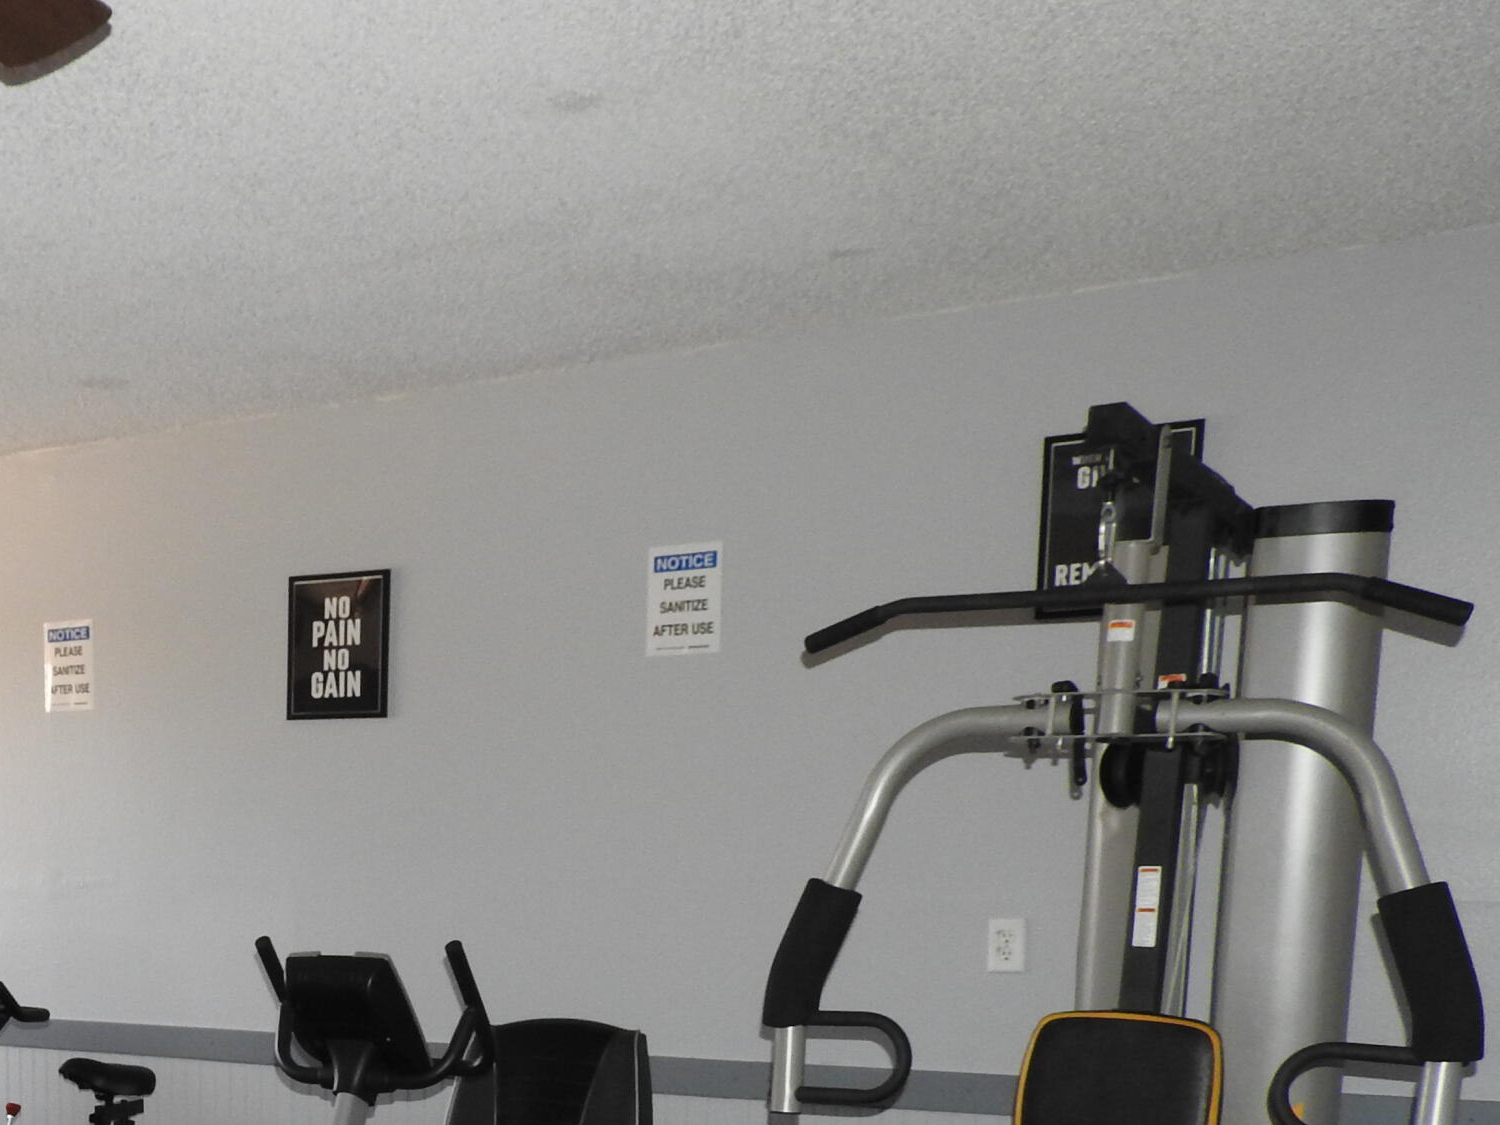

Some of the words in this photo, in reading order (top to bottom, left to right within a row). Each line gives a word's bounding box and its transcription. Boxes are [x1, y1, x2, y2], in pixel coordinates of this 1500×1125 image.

[656, 552, 715, 571] NOTICE
[663, 575, 706, 591] PLEASE
[324, 596, 351, 620] NO
[660, 598, 708, 614] SANITIZE
[49, 628, 88, 641] NOTICE
[312, 618, 361, 648] PAIN
[653, 623, 688, 637] AFTER
[691, 621, 714, 635] USE
[54, 645, 83, 658] PLEASE
[323, 648, 350, 671] NO
[53, 664, 85, 677] SANITIZE
[51, 684, 73, 695] AFTER
[74, 683, 90, 694] USE
[310, 670, 361, 699] GAIN
